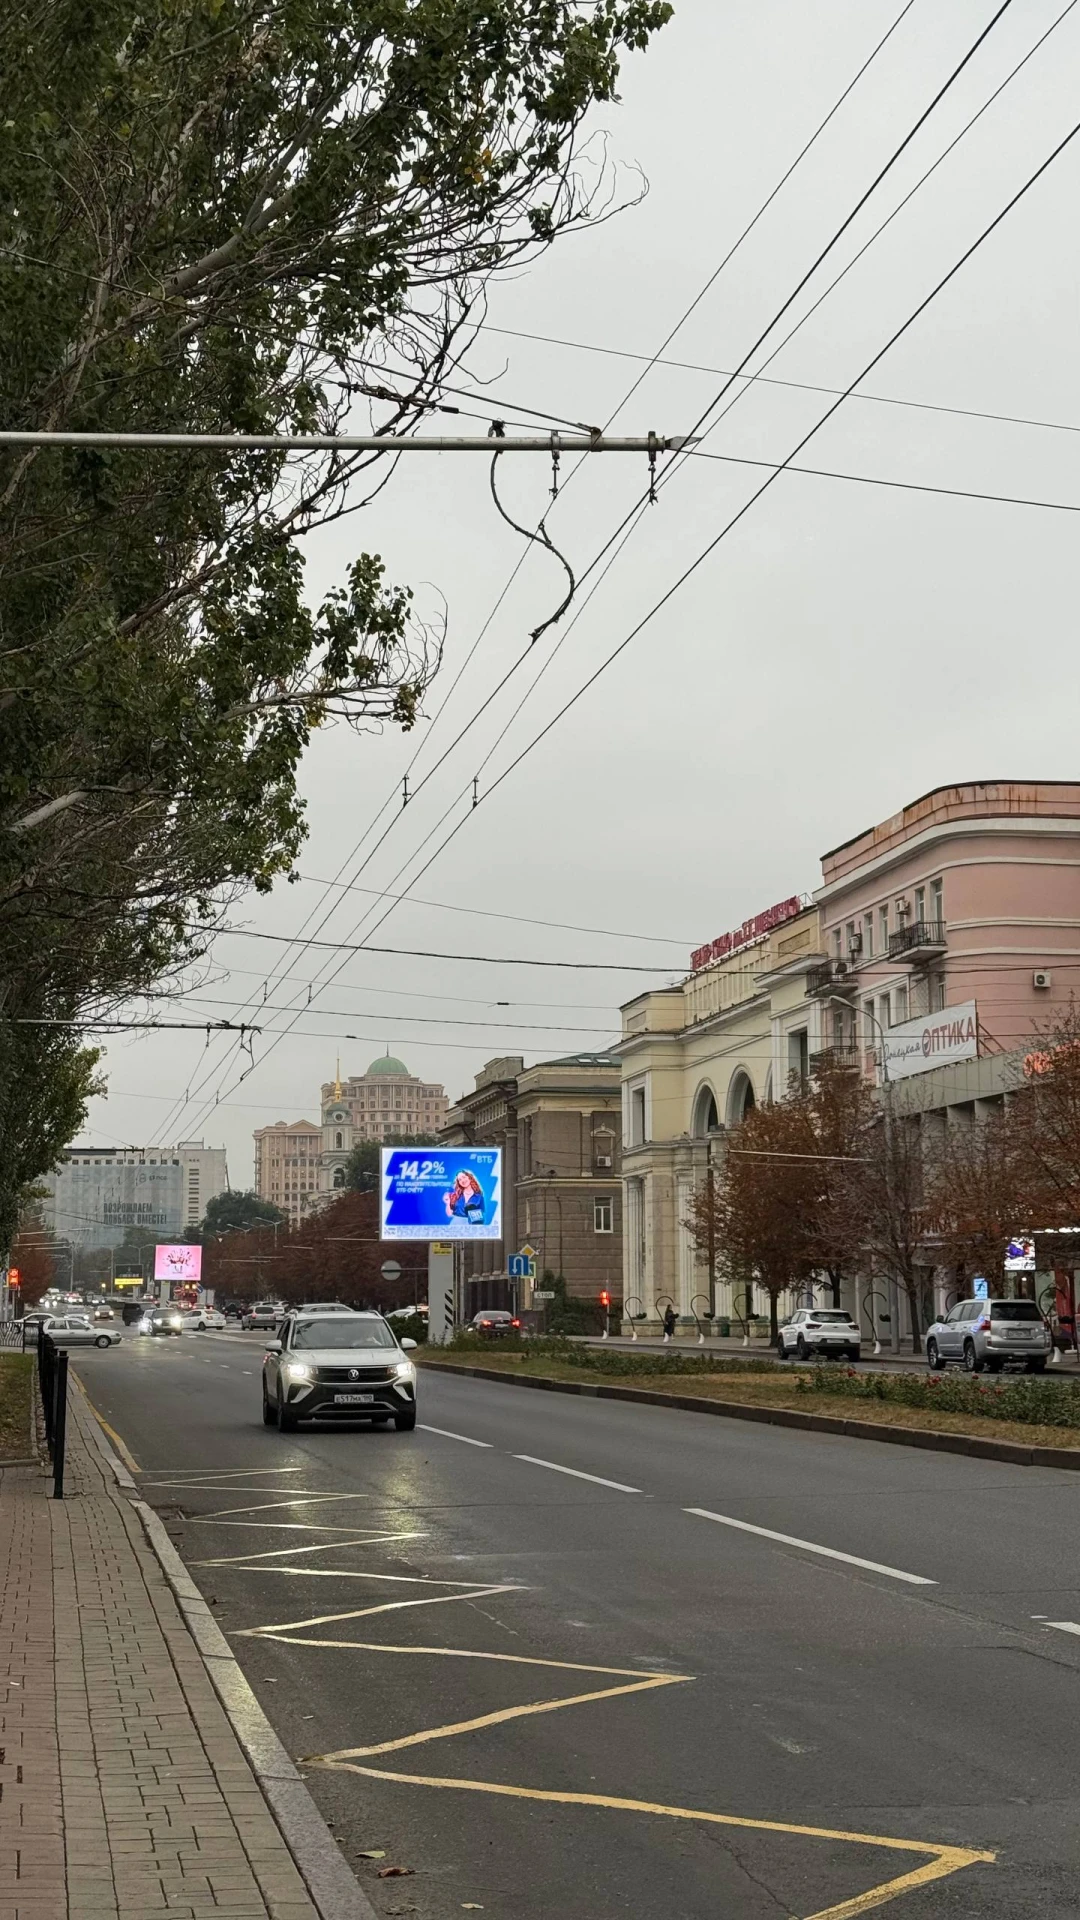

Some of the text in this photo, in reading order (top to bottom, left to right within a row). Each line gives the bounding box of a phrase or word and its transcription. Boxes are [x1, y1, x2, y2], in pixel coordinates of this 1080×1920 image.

[922, 1016, 975, 1057] ОПТИКА
[477, 1155, 493, 1164] ВТБ
[399, 1160, 445, 1180] 14,2%
[103, 1202, 153, 1213] ВОЗРОЖДАЕМ
[103, 1214, 135, 1225] ДОНБАСС
